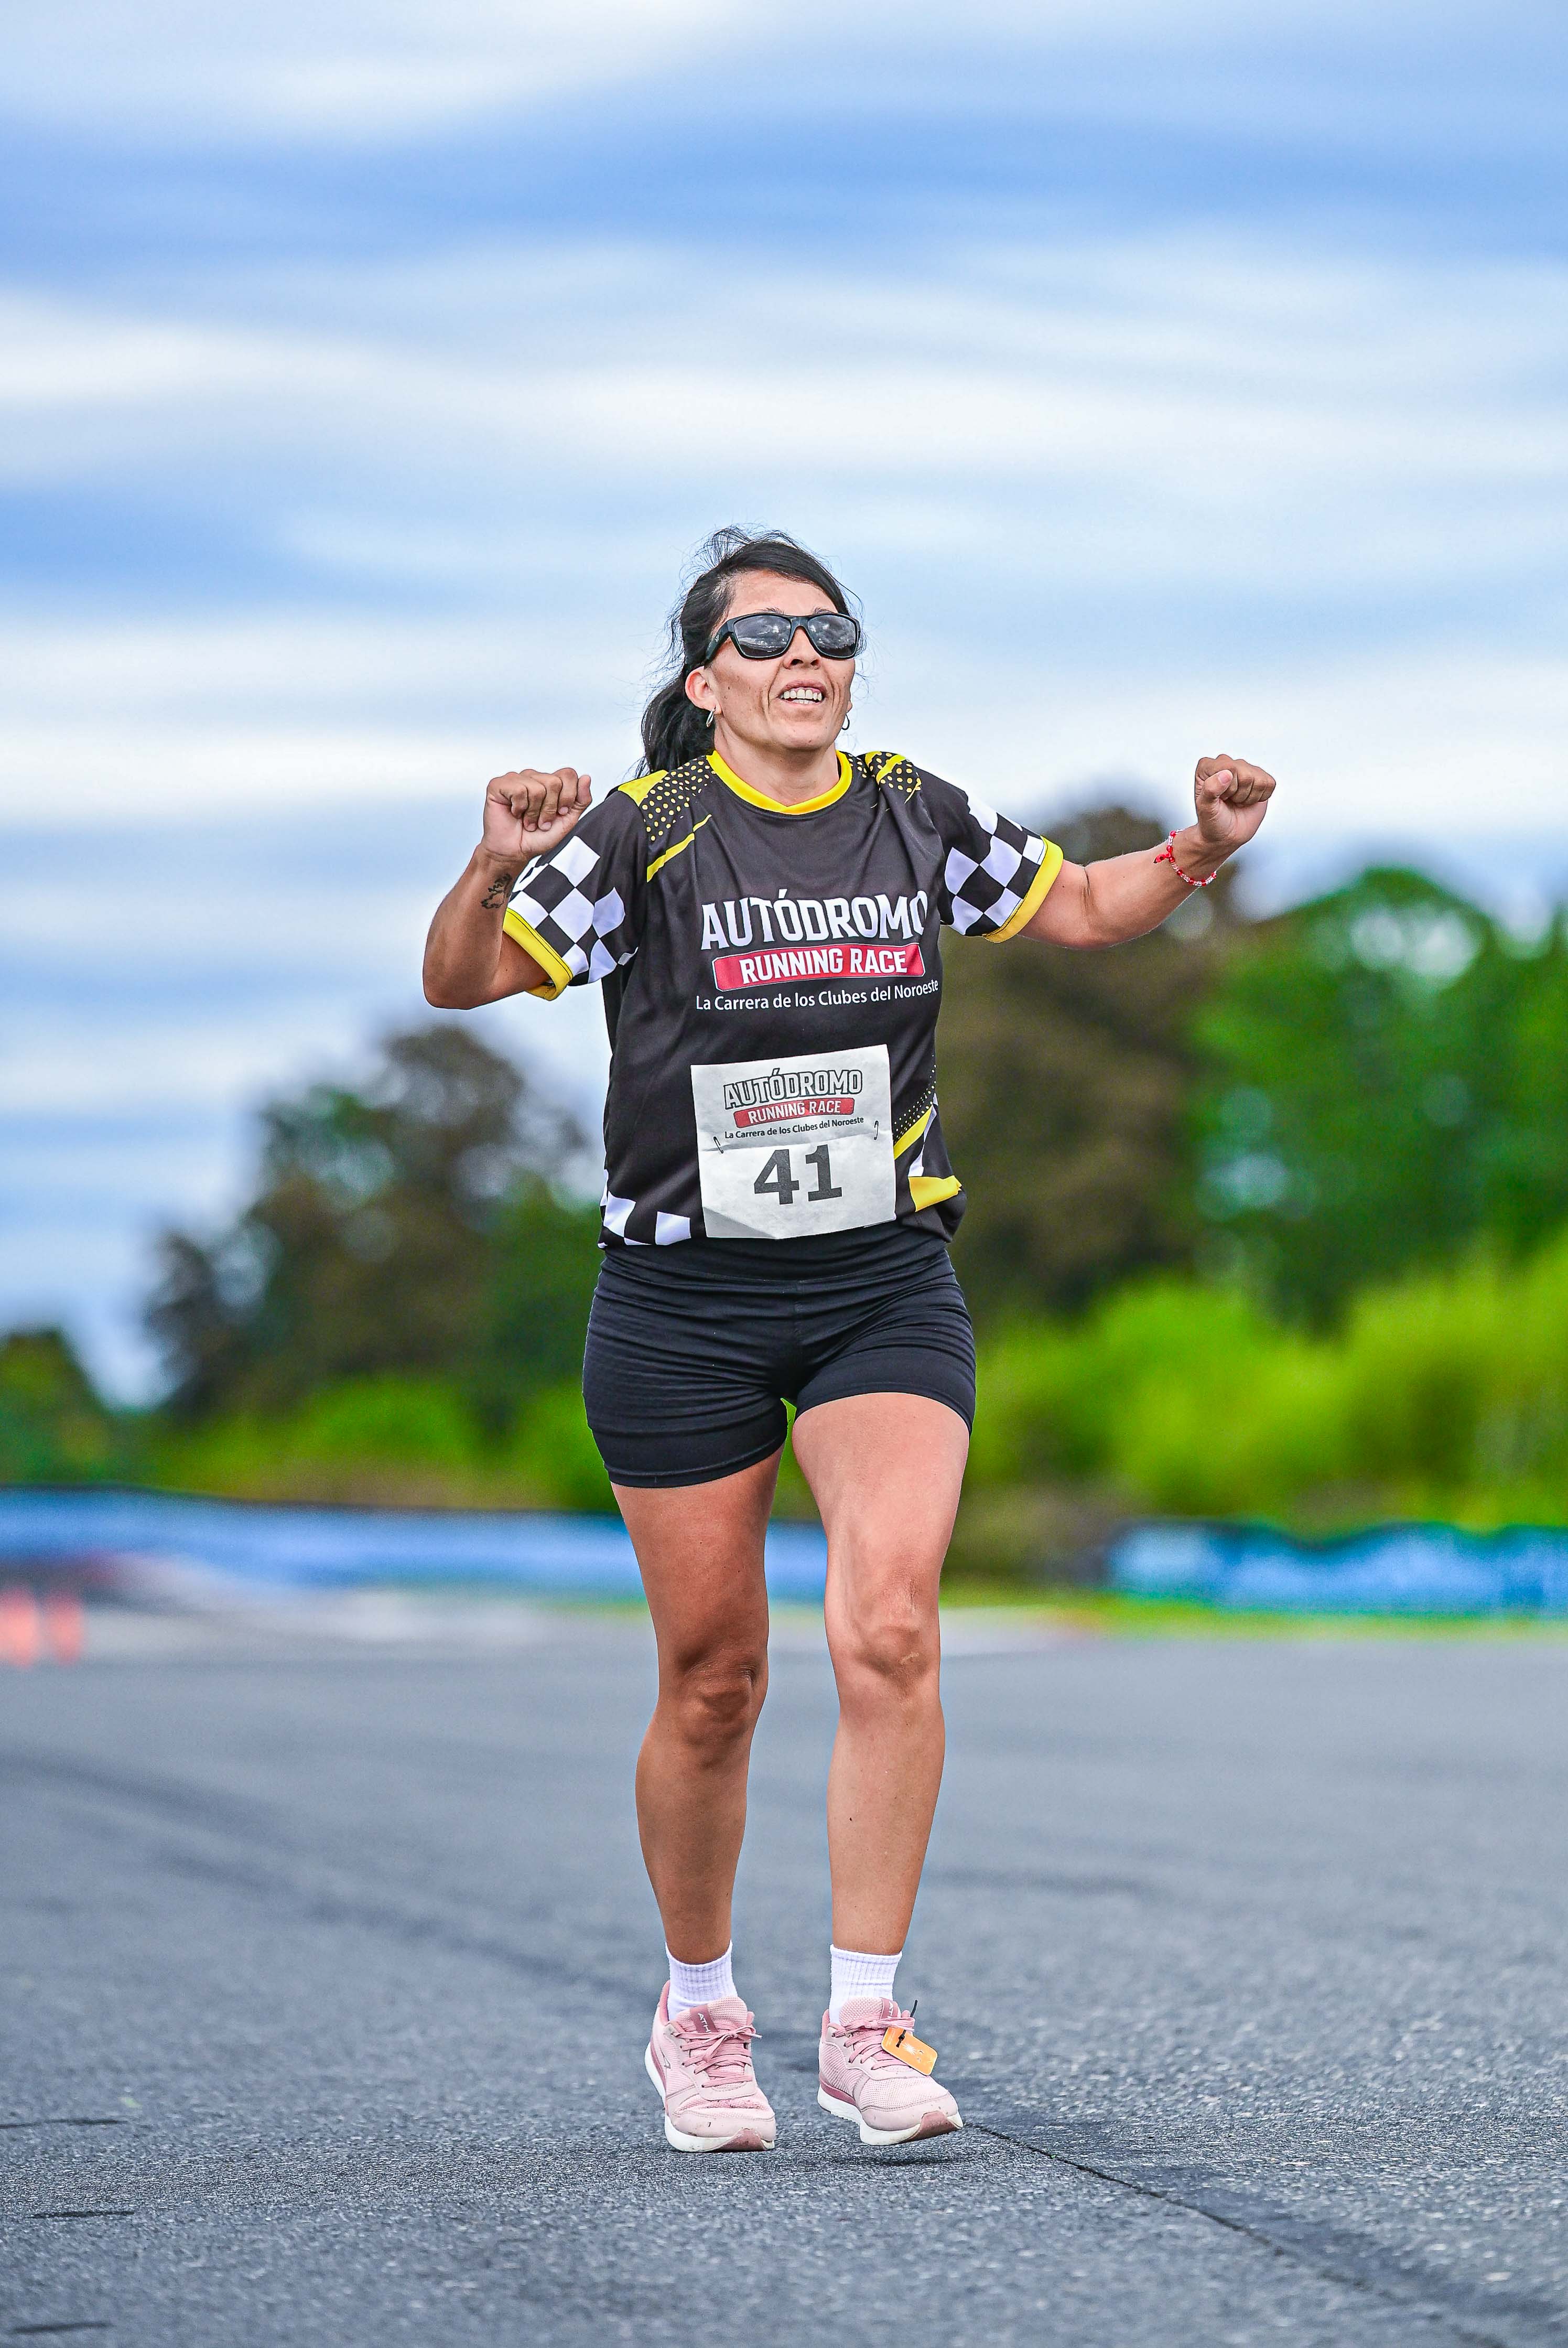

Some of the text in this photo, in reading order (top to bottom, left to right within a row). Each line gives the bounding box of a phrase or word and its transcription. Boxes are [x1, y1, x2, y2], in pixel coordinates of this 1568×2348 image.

[700, 889, 928, 950] AUTÓDROMO
[739, 948, 907, 984] RUNNING RACE
[696, 979, 938, 1010] La Carrera de los Clubes del Noroeste
[723, 1068, 863, 1110] AUTÓDROMO
[748, 1101, 841, 1124] RUNNING RACE
[792, 1125, 818, 1133] Clubes
[831, 1116, 864, 1127] Noroeste
[753, 1144, 842, 1205] 41
[697, 2013, 711, 2032] ATH
